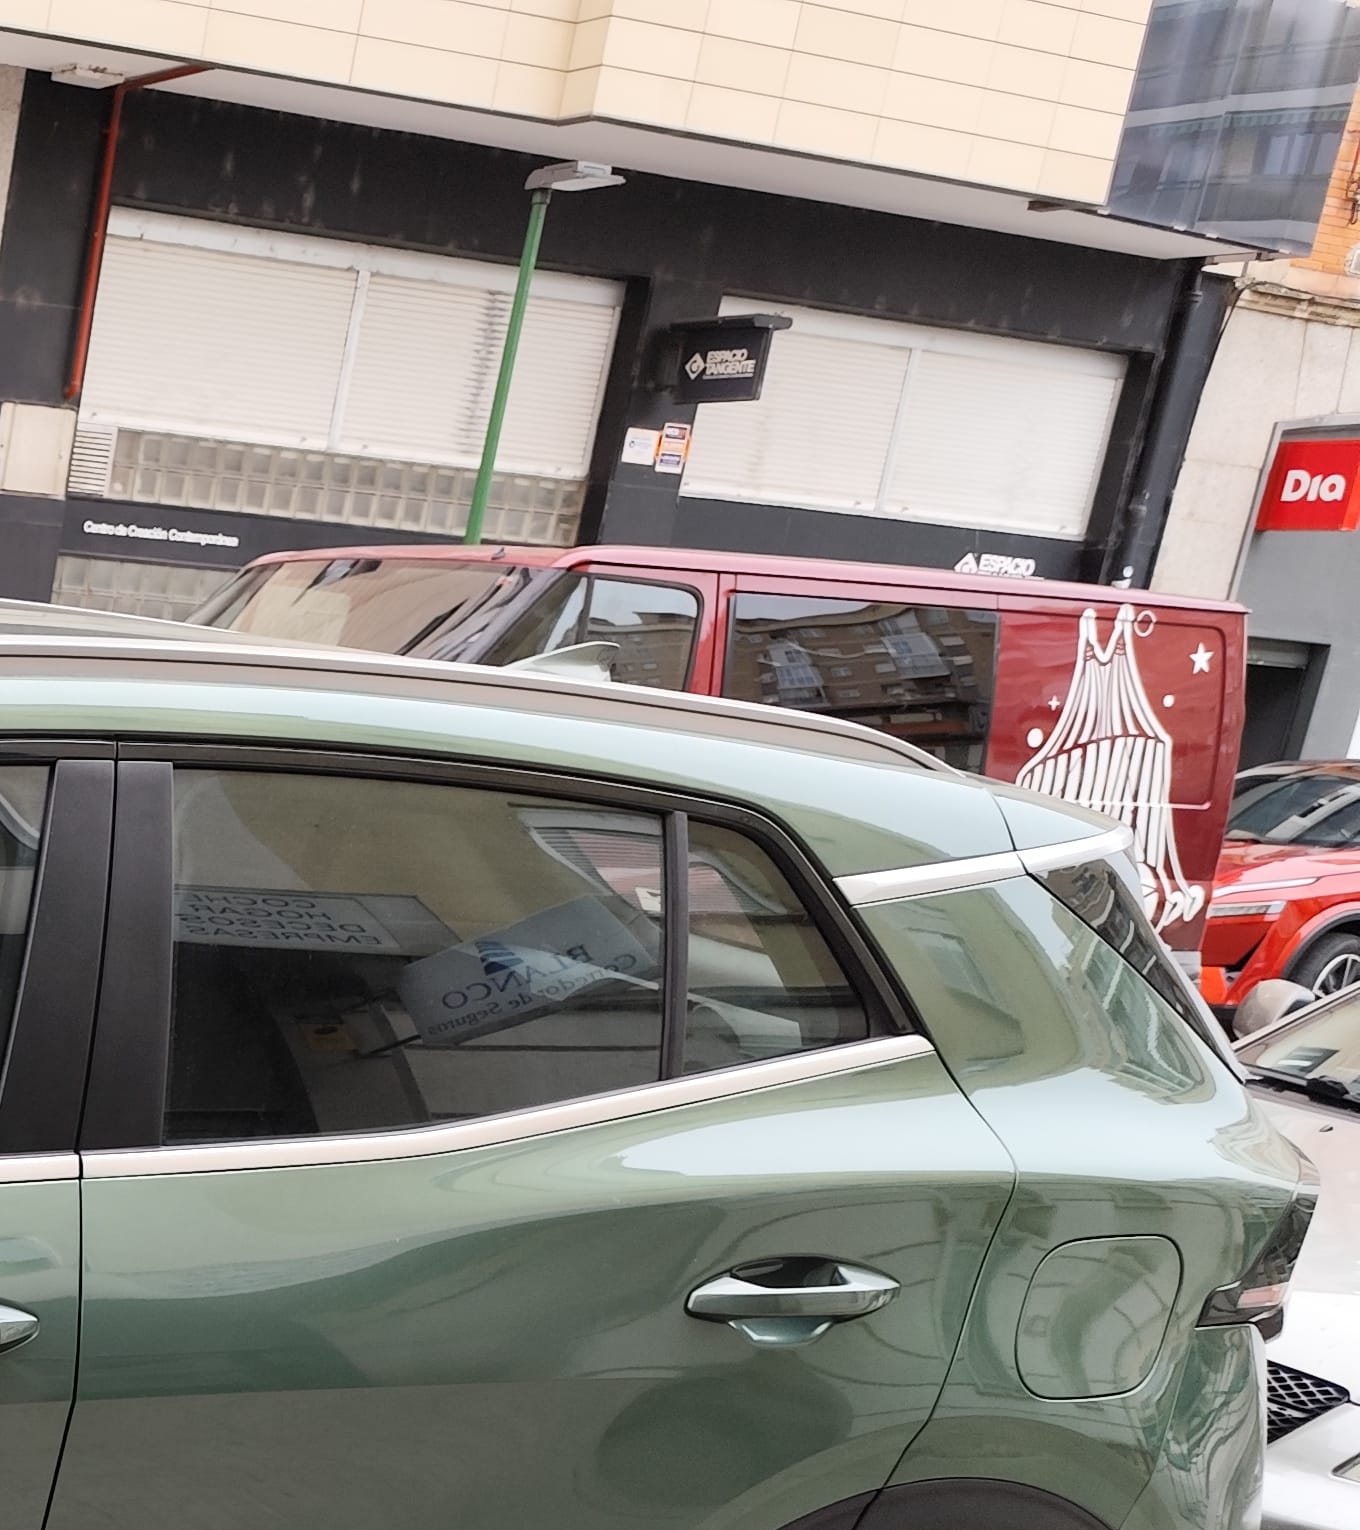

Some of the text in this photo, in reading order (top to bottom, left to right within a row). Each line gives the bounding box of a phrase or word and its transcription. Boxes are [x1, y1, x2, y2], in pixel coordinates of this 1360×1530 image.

[706, 348, 749, 364] ESPACIO
[705, 359, 757, 376] TANGENTE
[978, 553, 1036, 577] ESPACIO
